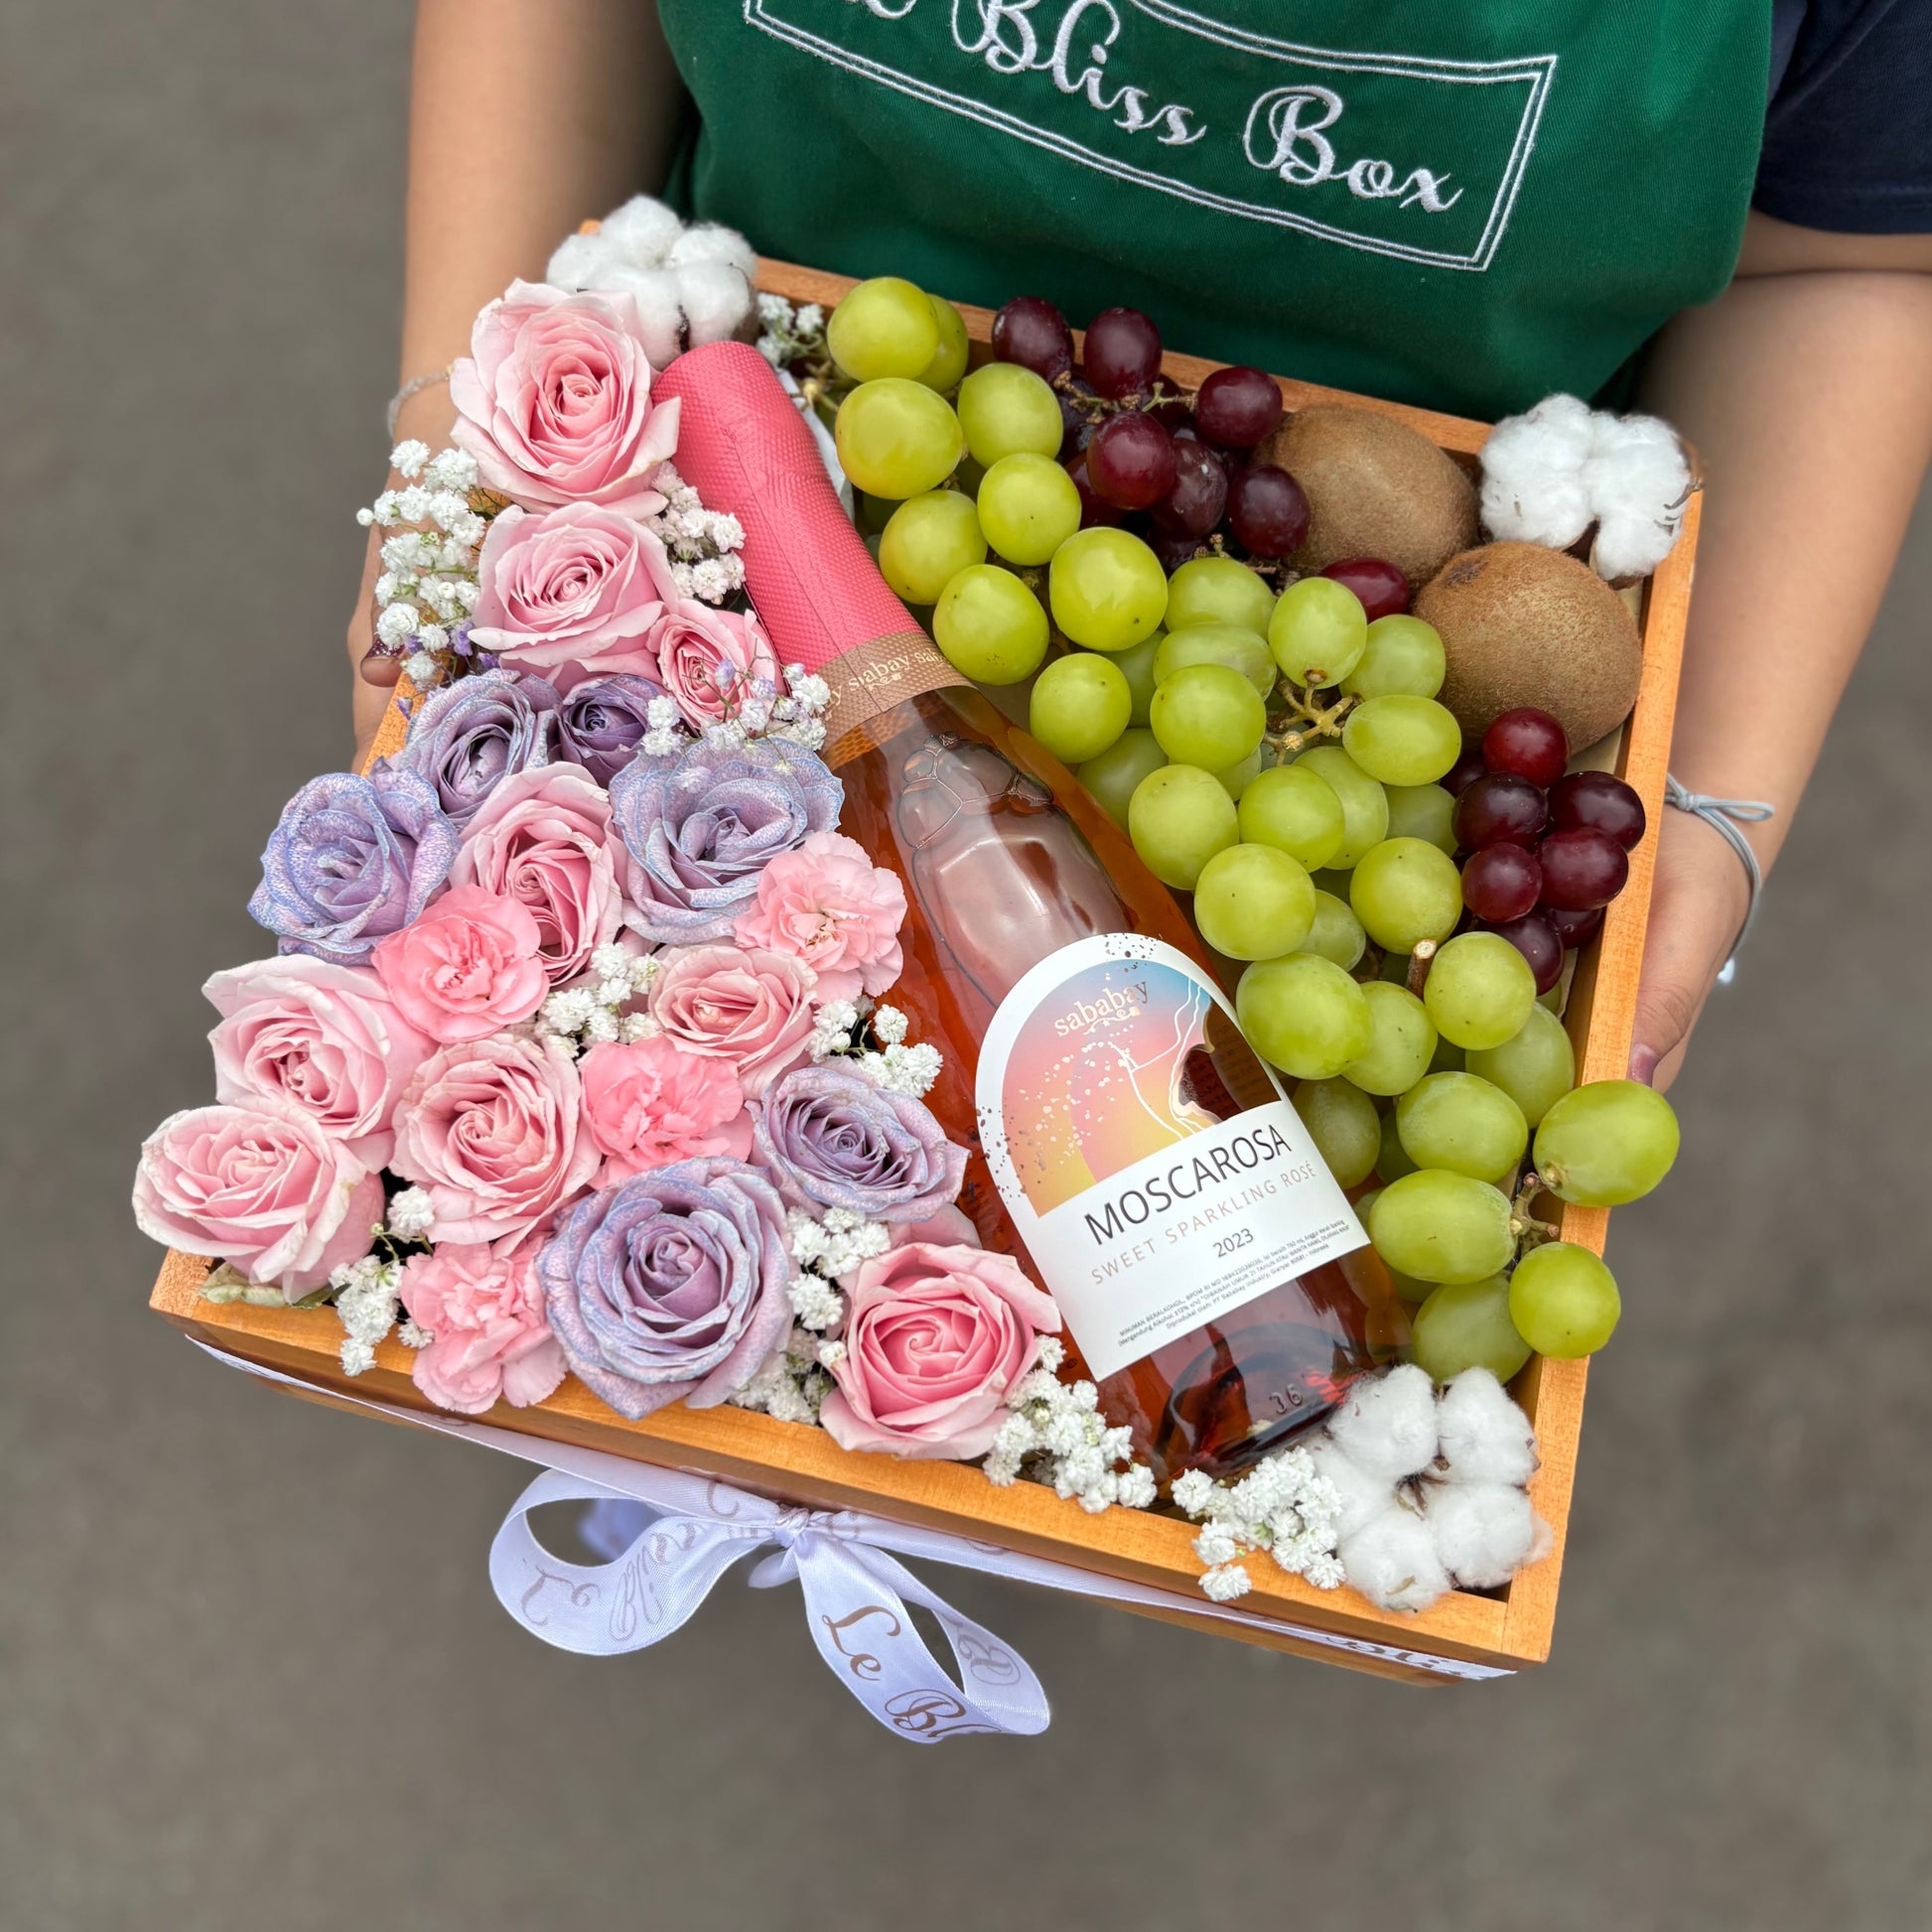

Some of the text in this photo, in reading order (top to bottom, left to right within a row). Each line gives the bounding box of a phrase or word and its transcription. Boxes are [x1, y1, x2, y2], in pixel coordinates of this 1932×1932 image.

[951, 0, 1463, 212] Bliss Box
[1054, 981, 1148, 1036] sababay
[1084, 1124, 1292, 1246] MOSCAROSA
[1091, 1160, 1316, 1285] SWEET SPARKLING ROSÉ
[1212, 1228, 1255, 1258] 2023
[822, 1605, 900, 1681] Le
